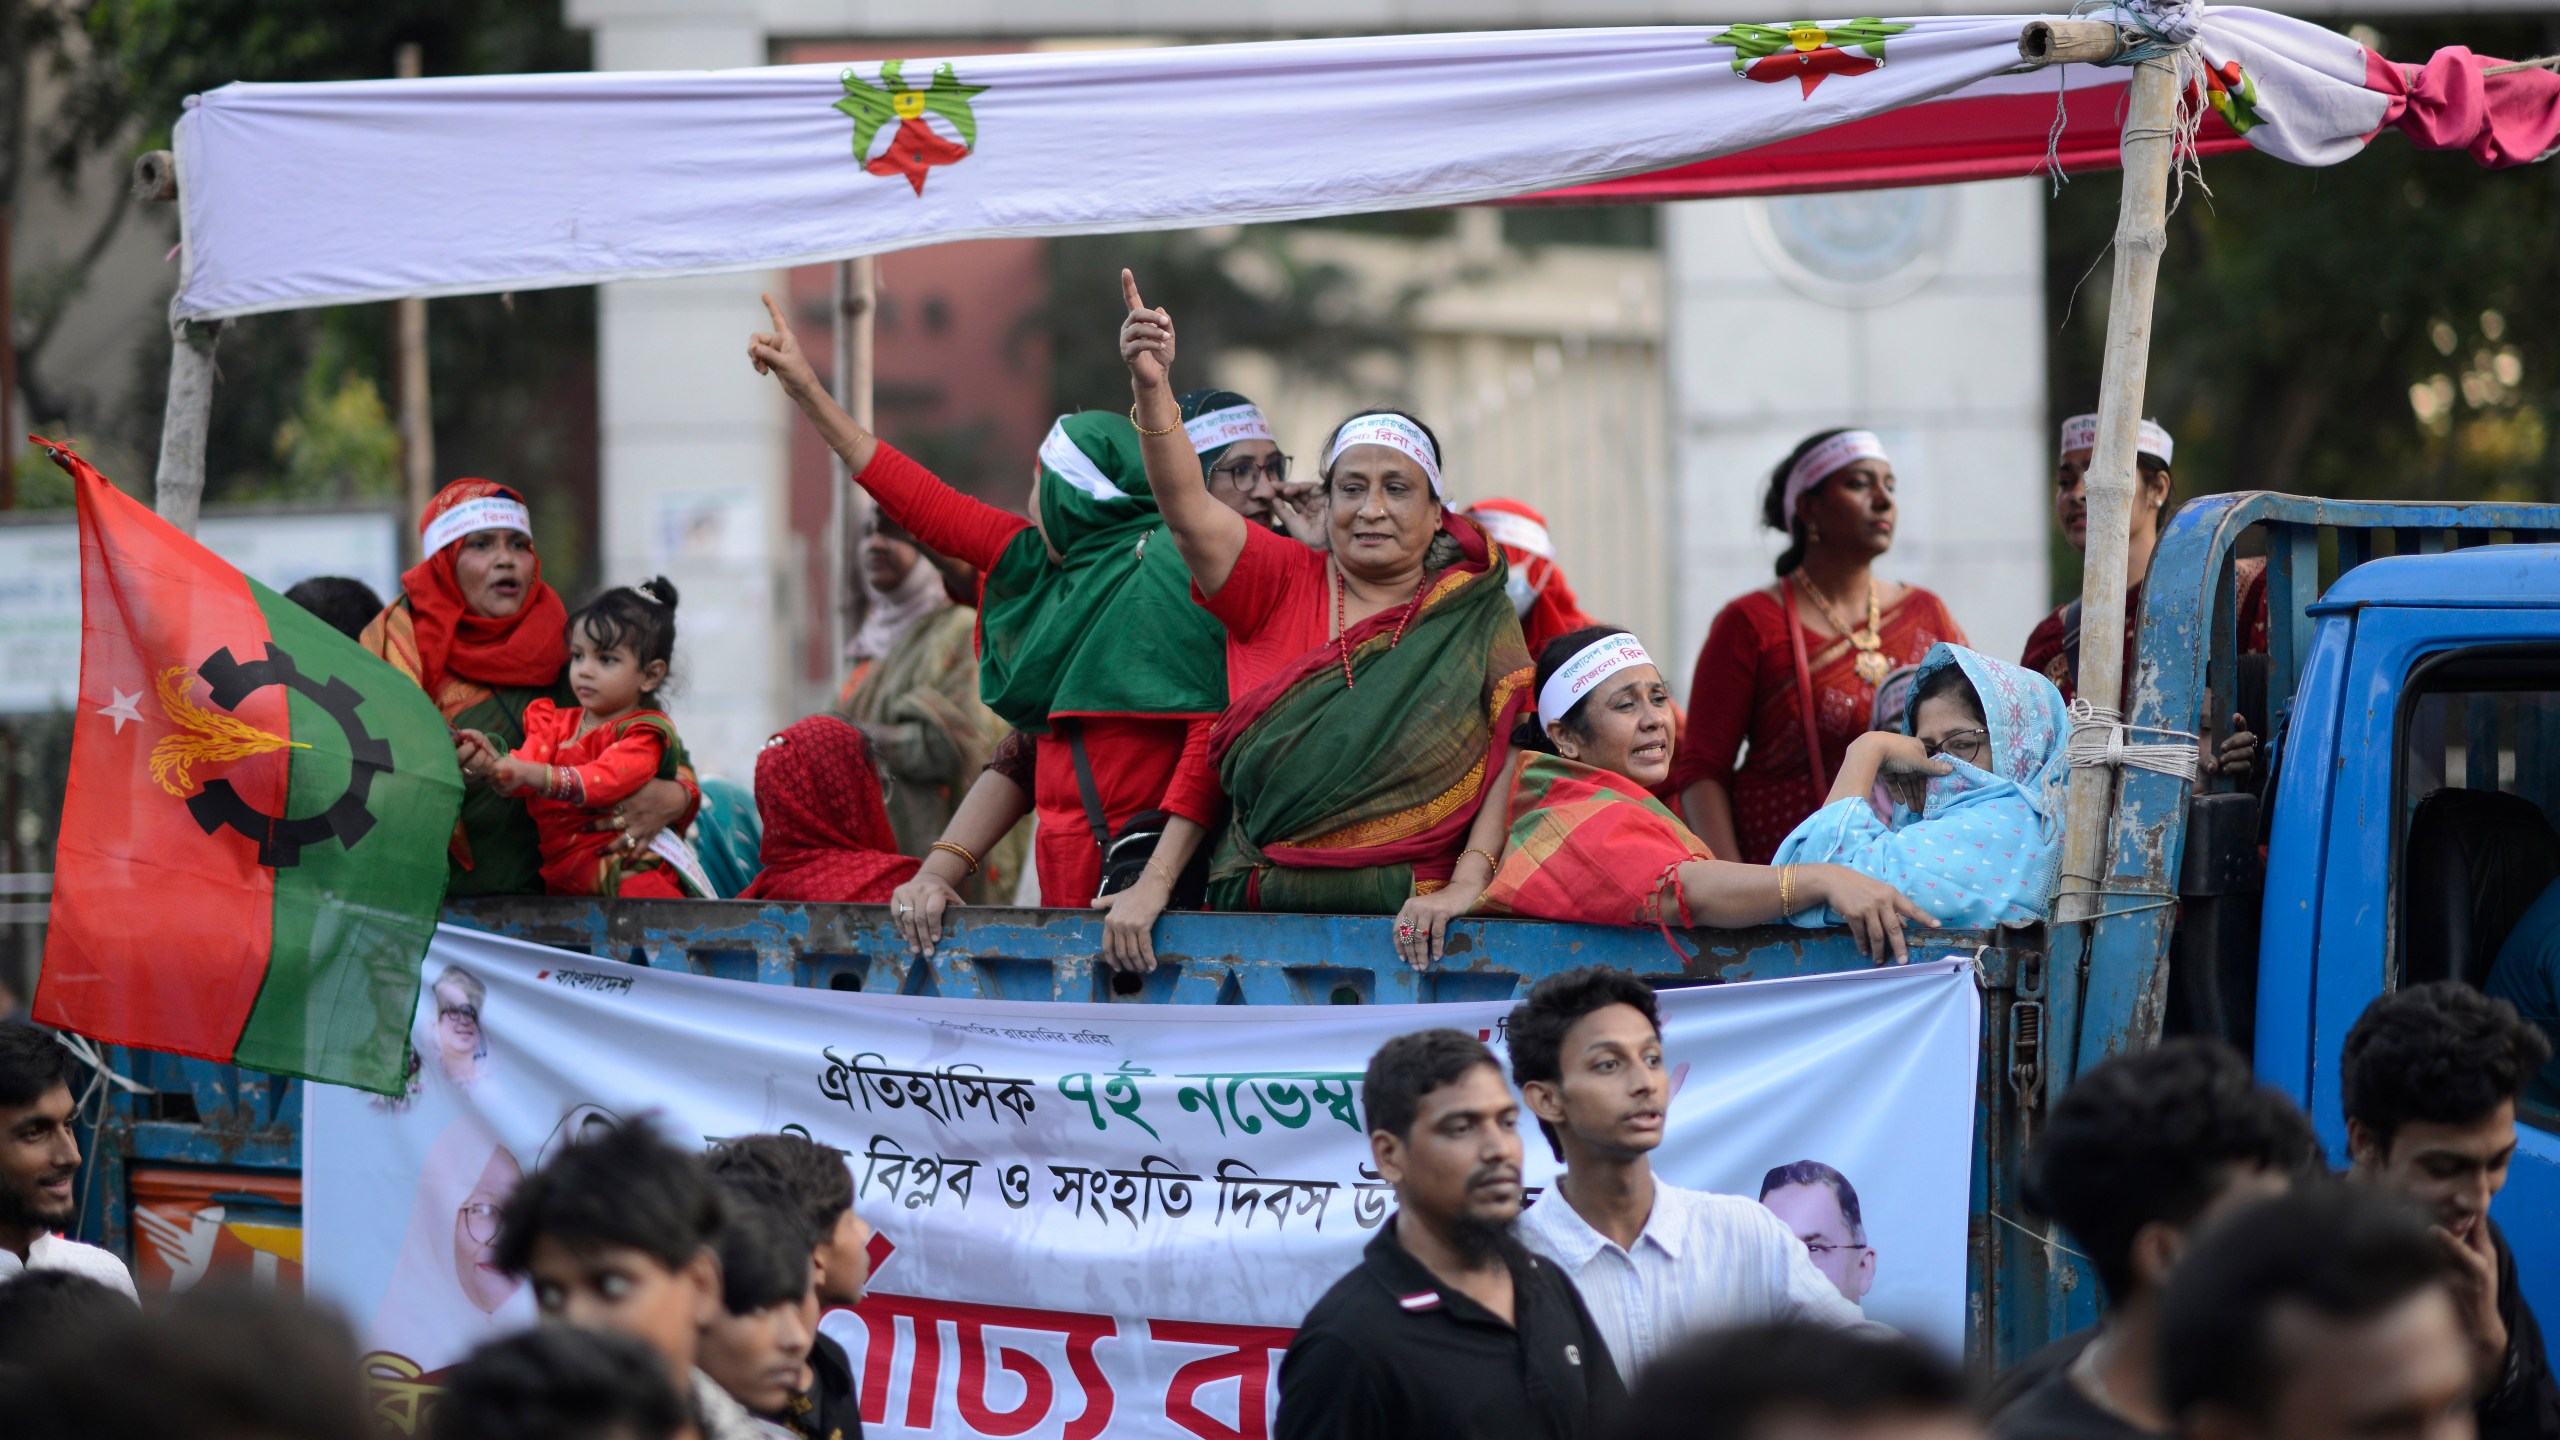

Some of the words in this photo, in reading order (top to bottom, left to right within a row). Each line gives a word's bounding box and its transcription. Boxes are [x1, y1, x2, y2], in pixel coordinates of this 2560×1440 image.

[1374, 427, 1410, 450] রিনা
[1561, 647, 1602, 680] বাংলাদেশ
[1571, 656, 1622, 694] সৌজন্যে:
[556, 968, 635, 996] বাংলাদেশ
[1068, 1029, 1115, 1047] রাহিম
[817, 1045, 1036, 1127] ঐতিহাসিক
[1058, 1060, 1162, 1143] ৭ই
[1174, 1071, 1366, 1139] নভেম্ব
[859, 1134, 983, 1211] বিপ্লব
[997, 1164, 1031, 1210] ও
[1047, 1154, 1204, 1233] সংহতি
[1213, 1158, 1342, 1233] দিবস
